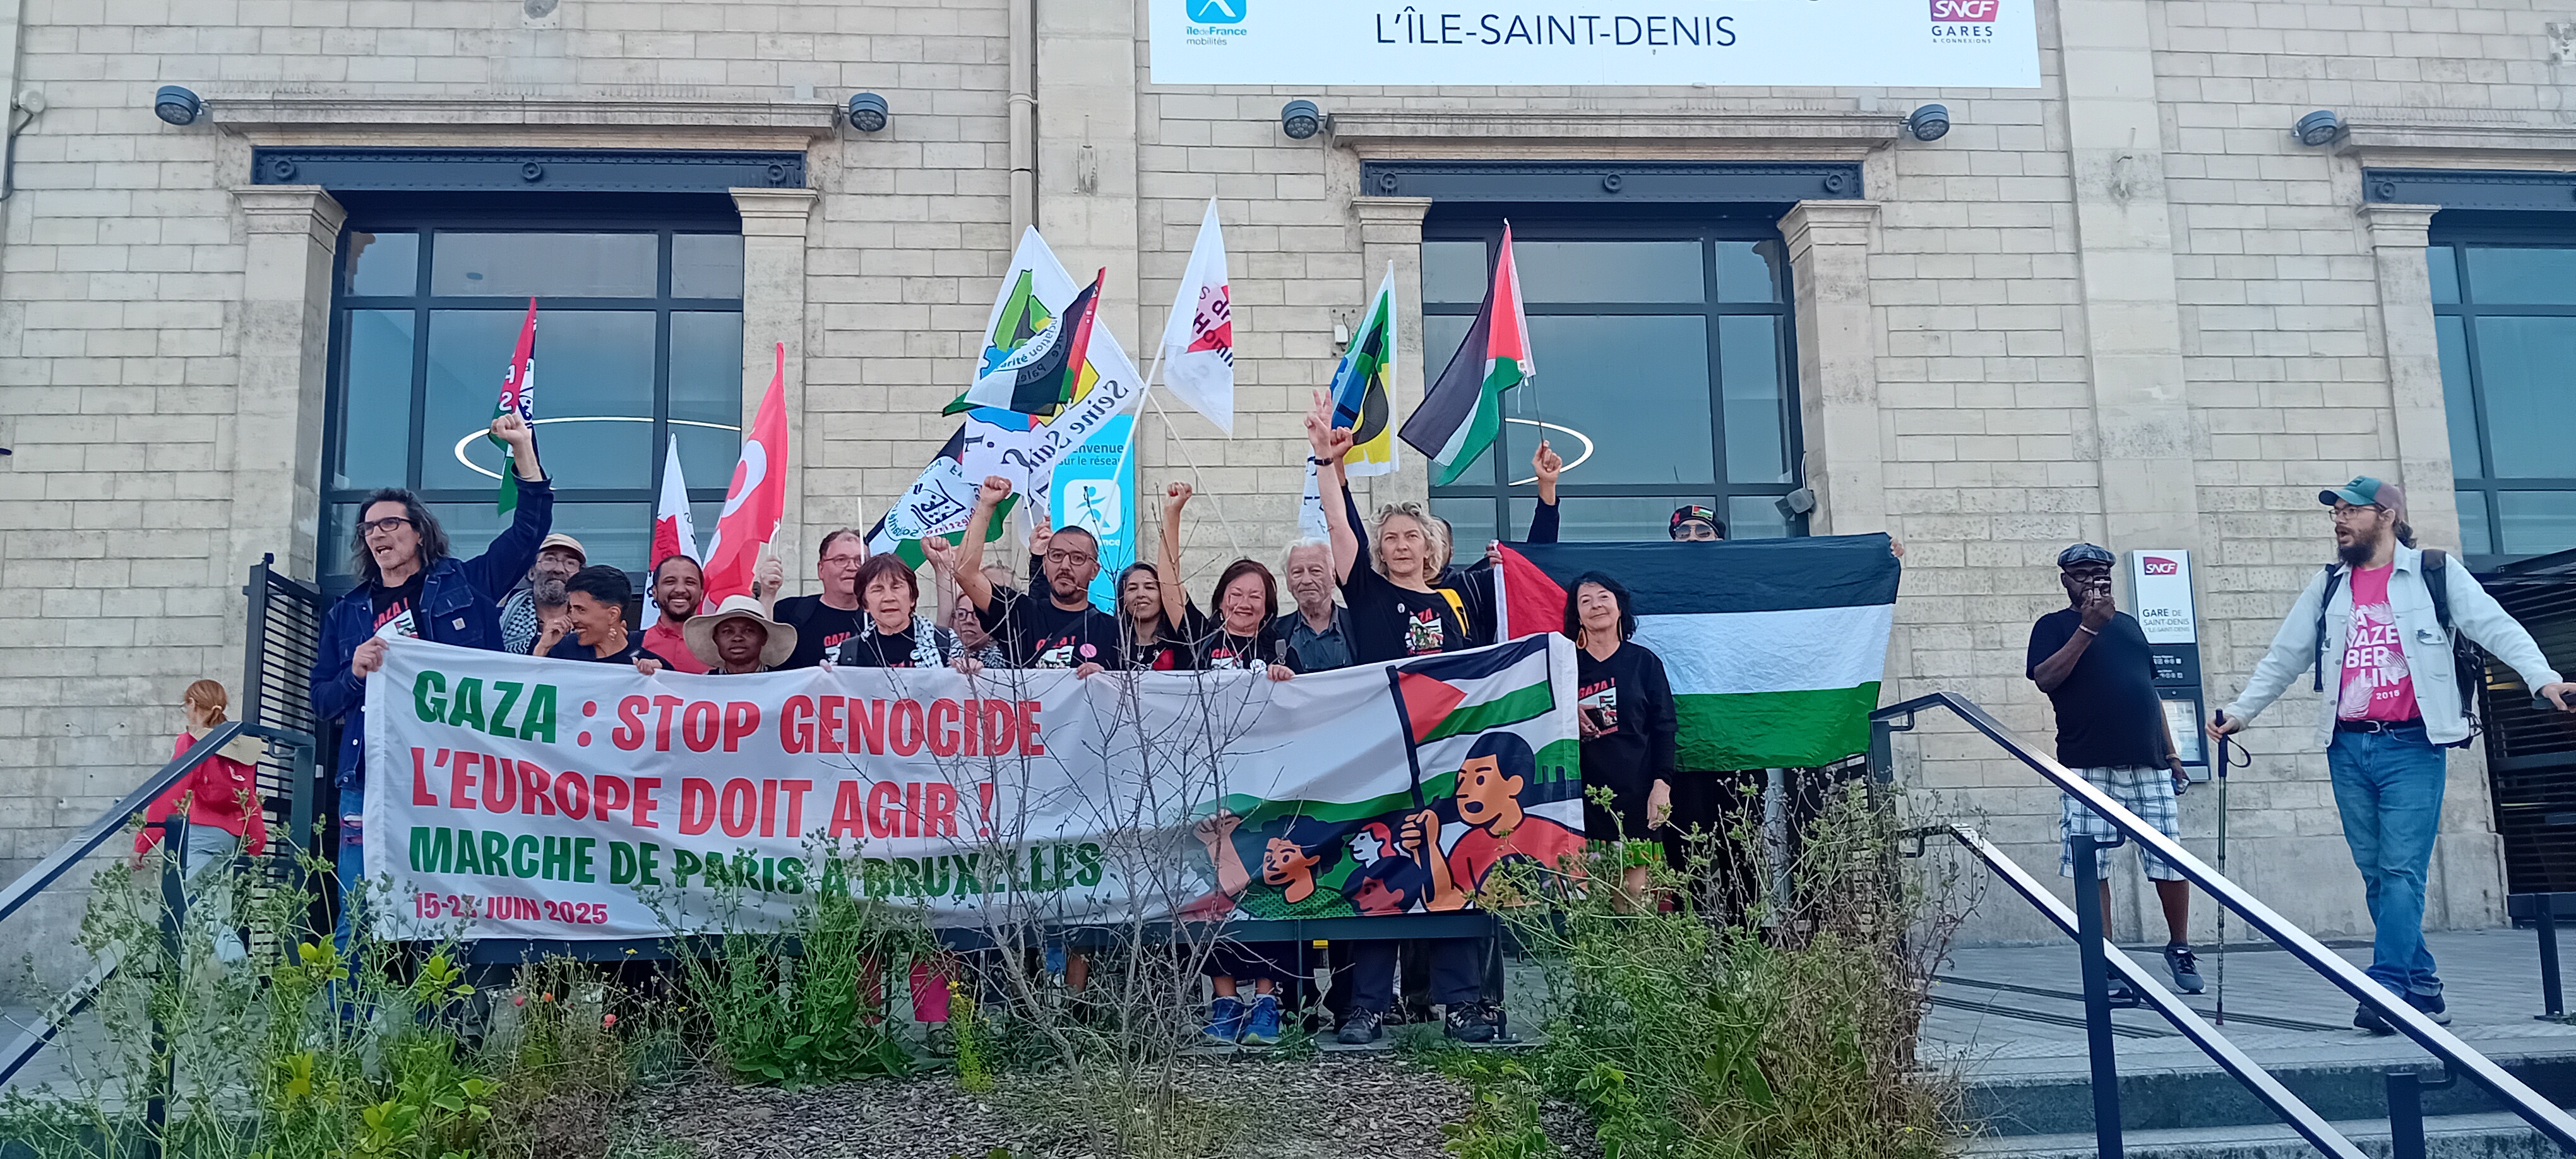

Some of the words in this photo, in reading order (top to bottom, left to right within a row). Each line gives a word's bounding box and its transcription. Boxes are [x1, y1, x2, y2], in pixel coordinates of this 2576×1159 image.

[1933, 0, 1995, 18] SNCF
[1376, 6, 1737, 47] L'ÎLE-SAINT-DENIS
[1931, 25, 1993, 36] GARES
[1186, 37, 1227, 45] mobilités
[1078, 456, 1087, 466] le
[2145, 563, 2176, 574] SNCF
[2142, 609, 2169, 617] GARE
[1578, 680, 1608, 699] GAZA
[412, 670, 558, 744] GAZA
[576, 700, 597, 747] :
[611, 694, 761, 752] STOP
[780, 694, 1045, 757] GENOCIDE
[410, 746, 662, 829] L'EUROPE
[679, 777, 813, 838] DOIT
[827, 780, 958, 838] AGIR
[979, 782, 994, 838] !
[409, 826, 596, 884] MARCHE
[609, 841, 661, 886] DE
[672, 848, 806, 895] PARIS
[485, 896, 541, 921] JUIN
[544, 900, 609, 925] 2025
